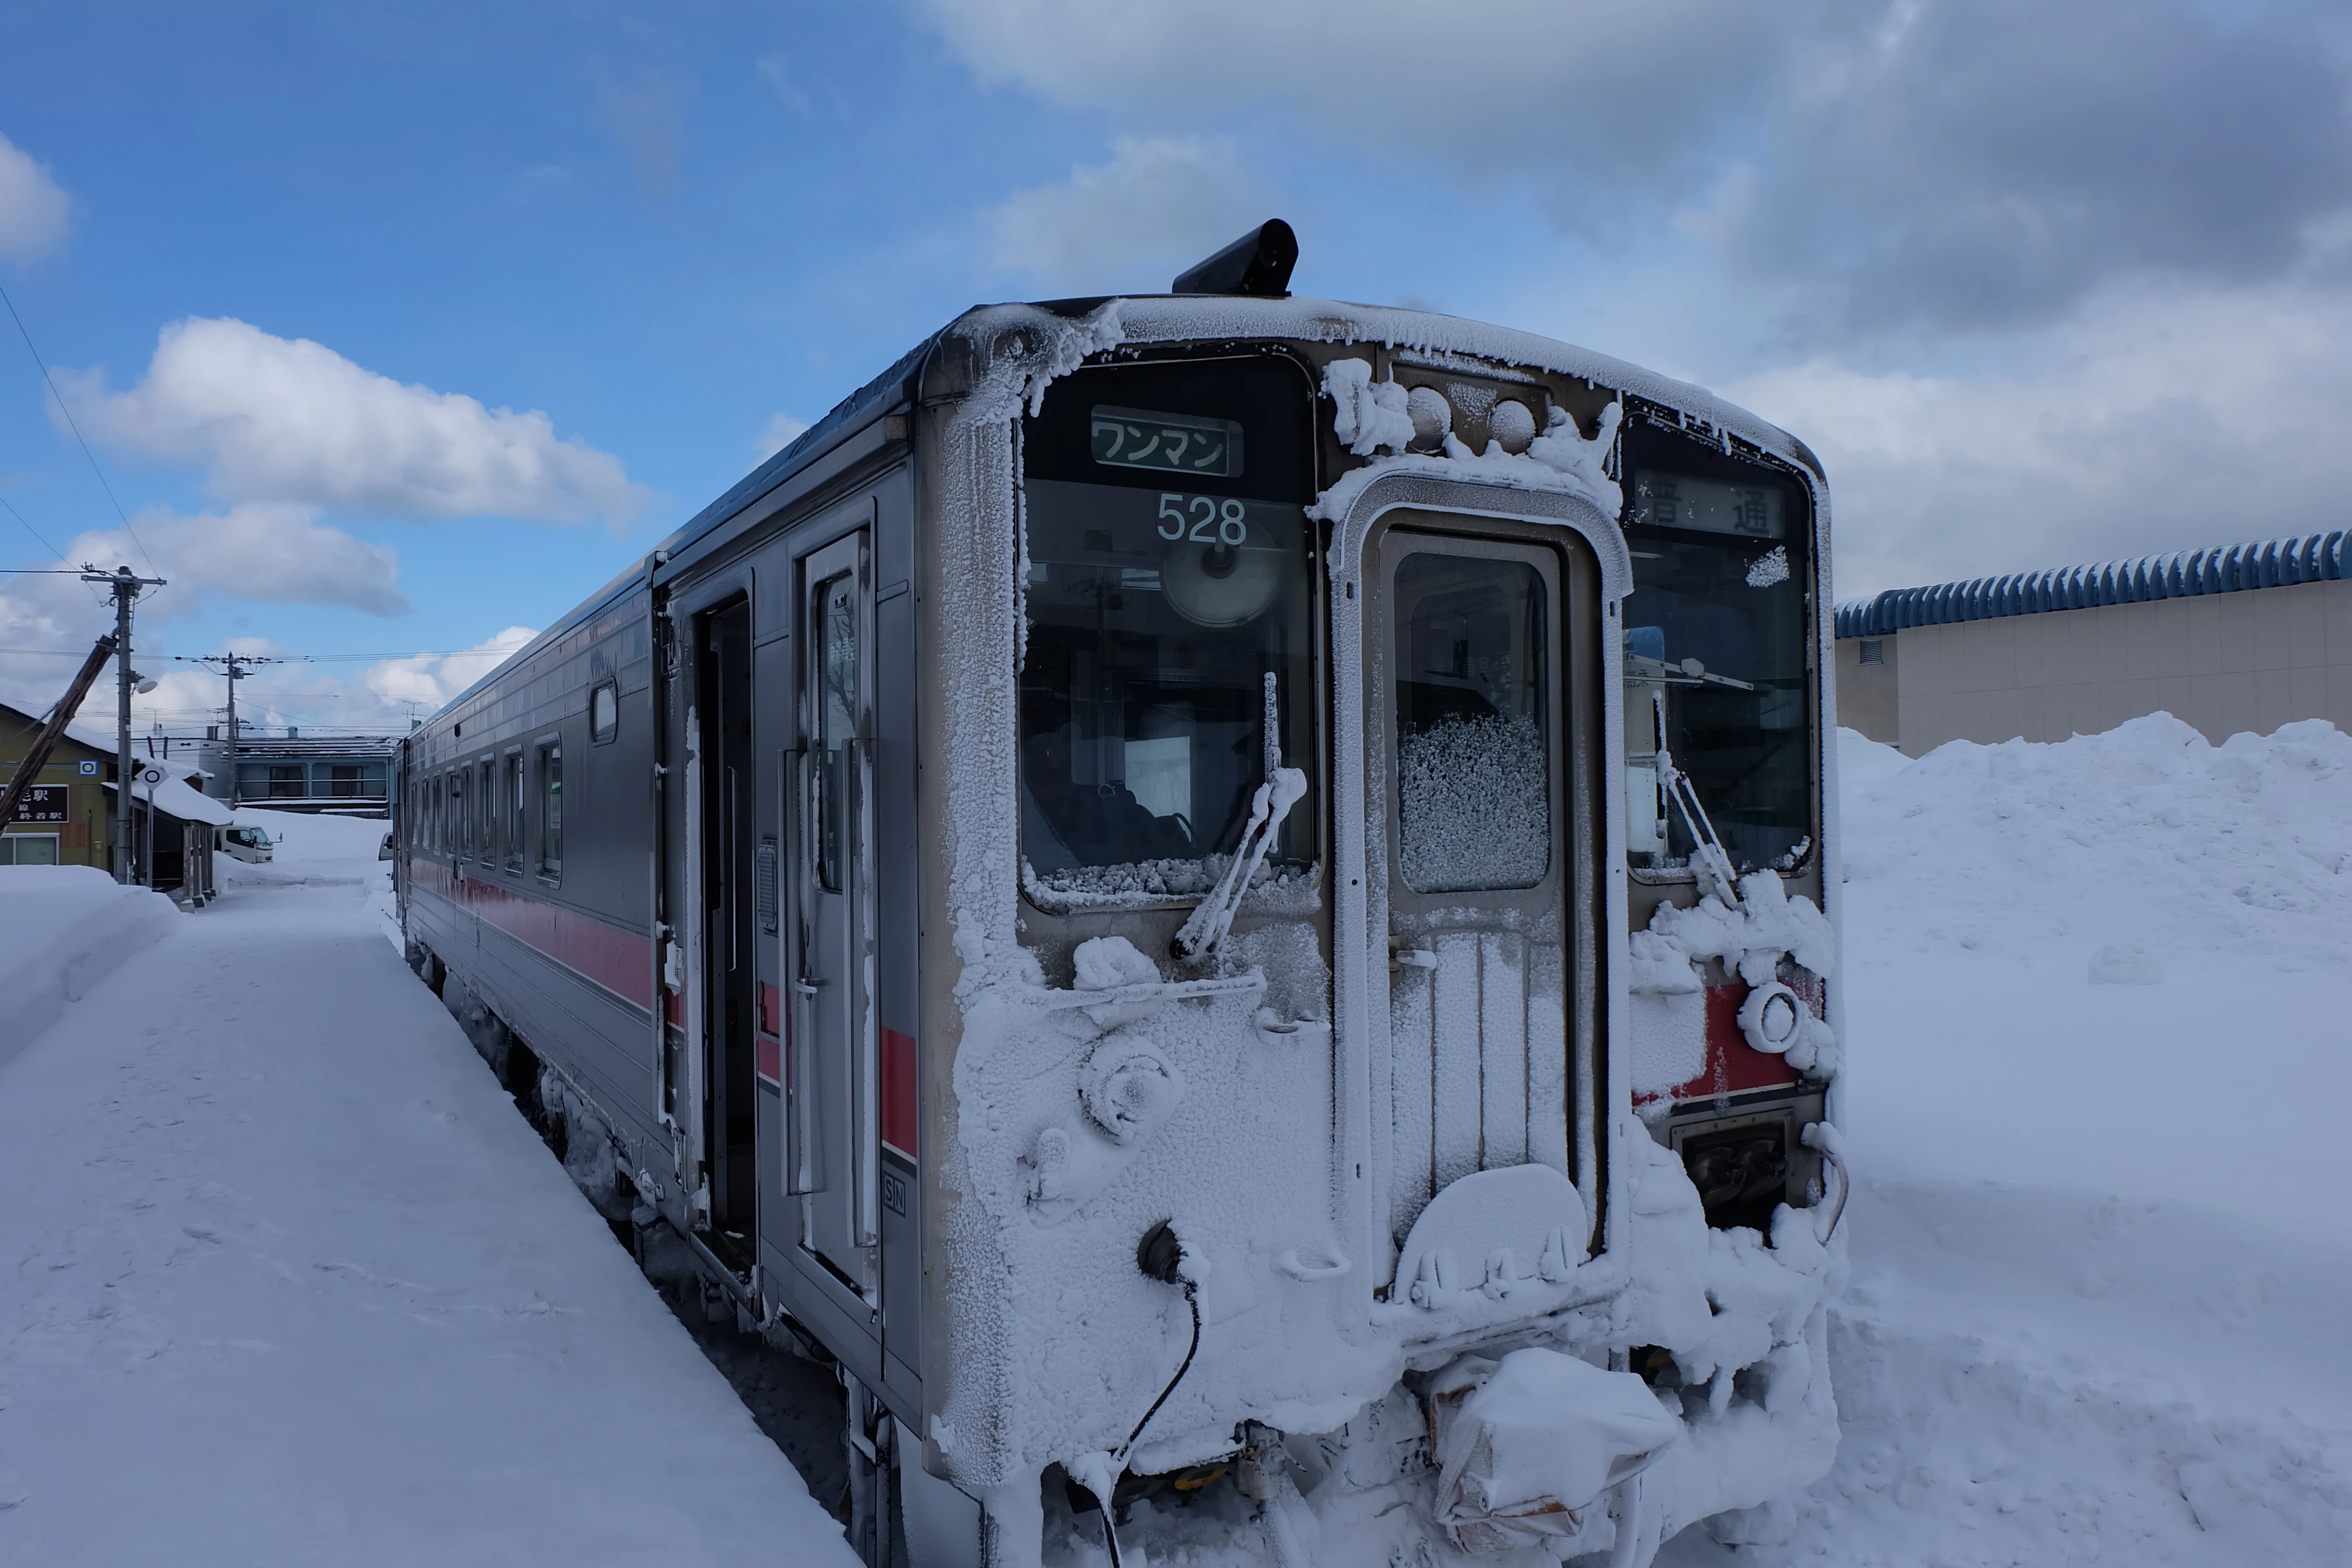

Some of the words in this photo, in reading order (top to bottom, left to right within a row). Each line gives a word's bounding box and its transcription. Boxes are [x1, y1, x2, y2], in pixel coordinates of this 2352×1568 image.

[1092, 421, 1223, 467] ワンマン
[1157, 493, 1246, 545] 528
[1646, 478, 1770, 535] 普通
